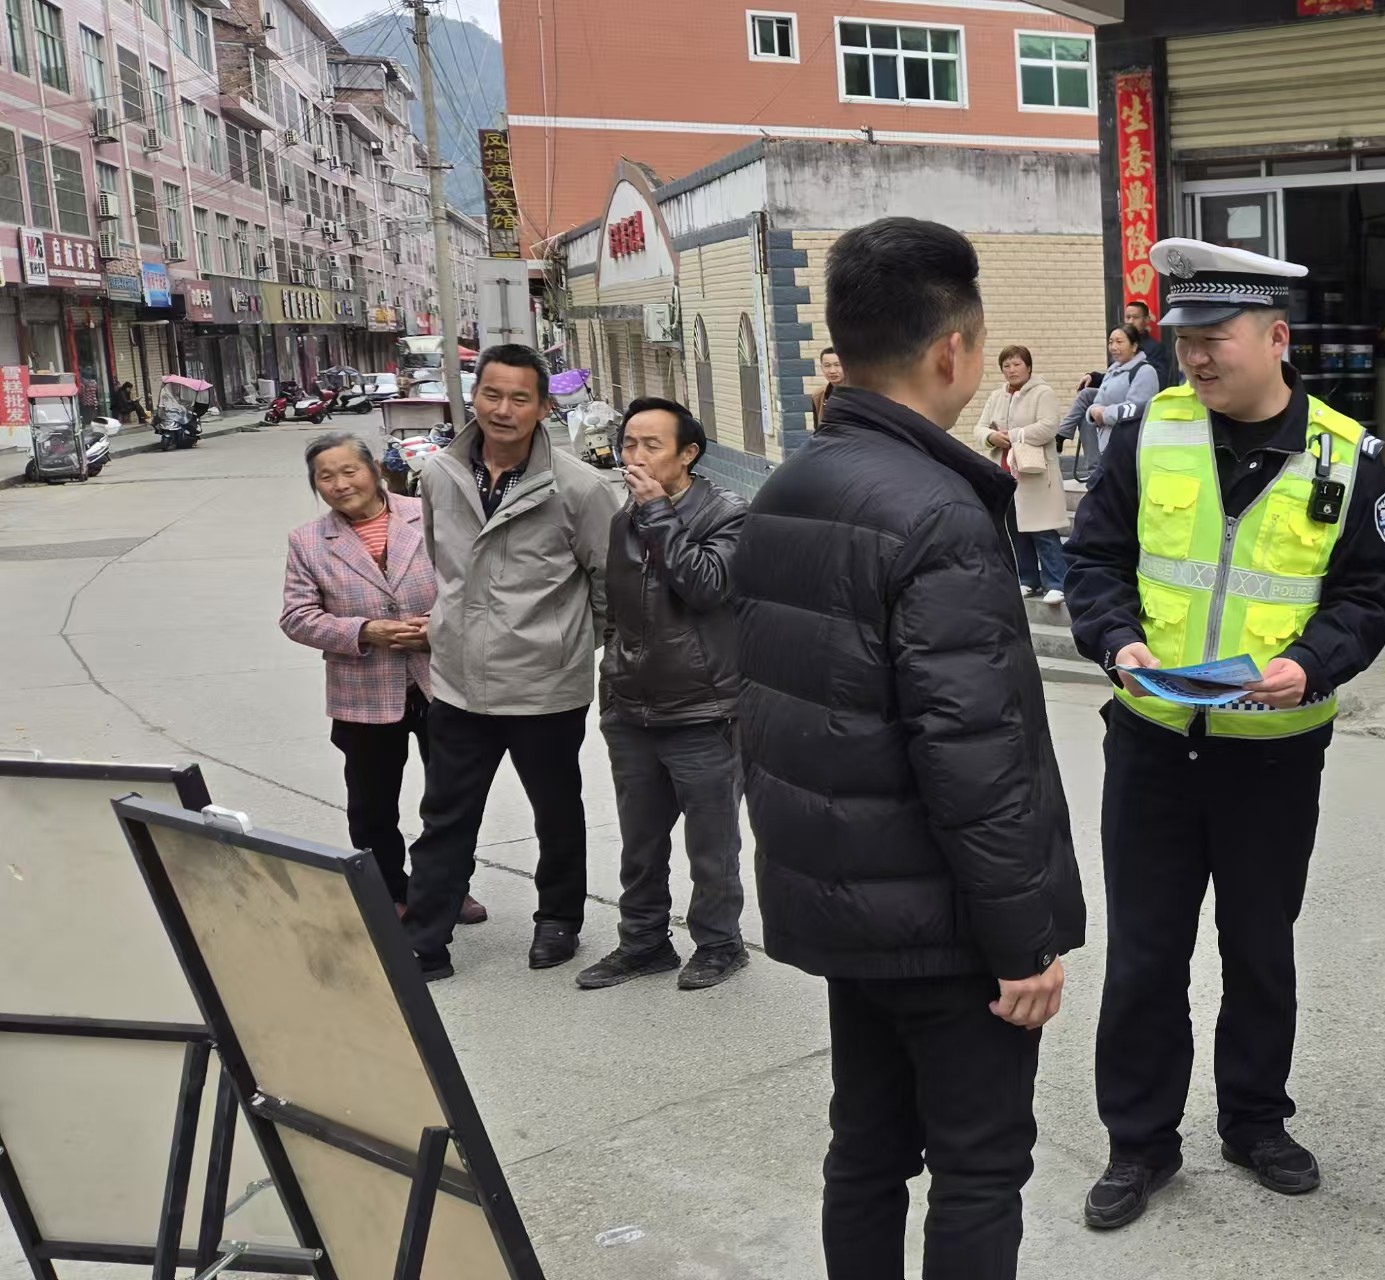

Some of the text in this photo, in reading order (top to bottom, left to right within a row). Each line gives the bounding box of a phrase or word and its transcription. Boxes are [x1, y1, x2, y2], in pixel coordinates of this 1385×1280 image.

[1121, 95, 1156, 322] 生意興隆四
[52, 238, 96, 270] 启航百货
[1271, 584, 1313, 597] POLICE
